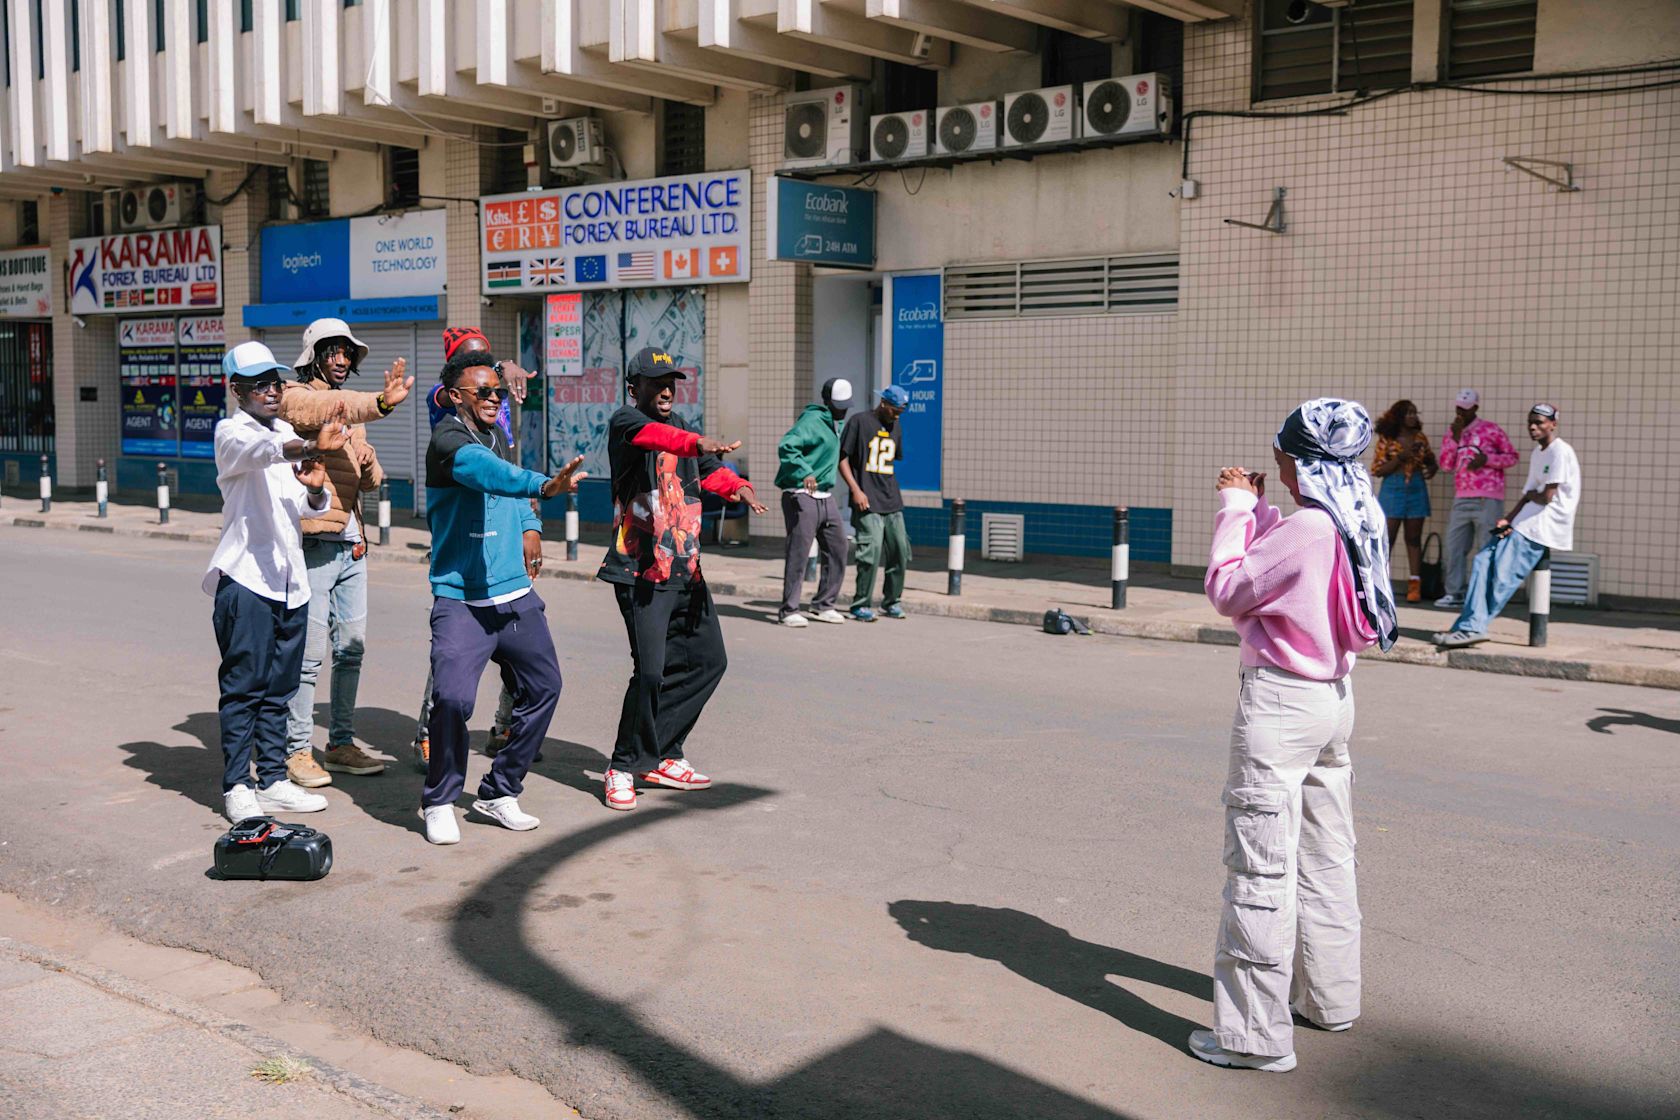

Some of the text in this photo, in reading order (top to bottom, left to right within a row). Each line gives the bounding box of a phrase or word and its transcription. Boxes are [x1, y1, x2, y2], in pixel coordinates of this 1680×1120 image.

[834, 106, 843, 114] LG
[1136, 98, 1147, 106] LG
[1055, 109, 1064, 117] LG
[980, 120, 990, 129] LG
[564, 178, 738, 220] CONFERENCE
[805, 189, 848, 214] Ecobank
[486, 208, 511, 226] Kshs.
[540, 200, 556, 221] $
[519, 227, 531, 248] R
[564, 212, 738, 245] FOREX BUREAU LTD.
[100, 228, 216, 271] KARAMA
[375, 236, 433, 254] ONE WORLD
[825, 240, 857, 254] 24H ATM
[9, 255, 46, 276] BOUTIQUE
[282, 252, 321, 274] logitech
[372, 256, 437, 273] TECHNOLOGY
[102, 264, 216, 287] FOREX BUREAU LTD
[899, 302, 938, 322] Ecobank
[135, 320, 175, 335] KARAMA
[912, 390, 935, 401] HOUR
[909, 403, 926, 413] ATM
[126, 416, 152, 428] AGENT
[185, 418, 212, 430] AGENT
[865, 436, 896, 475] 12
